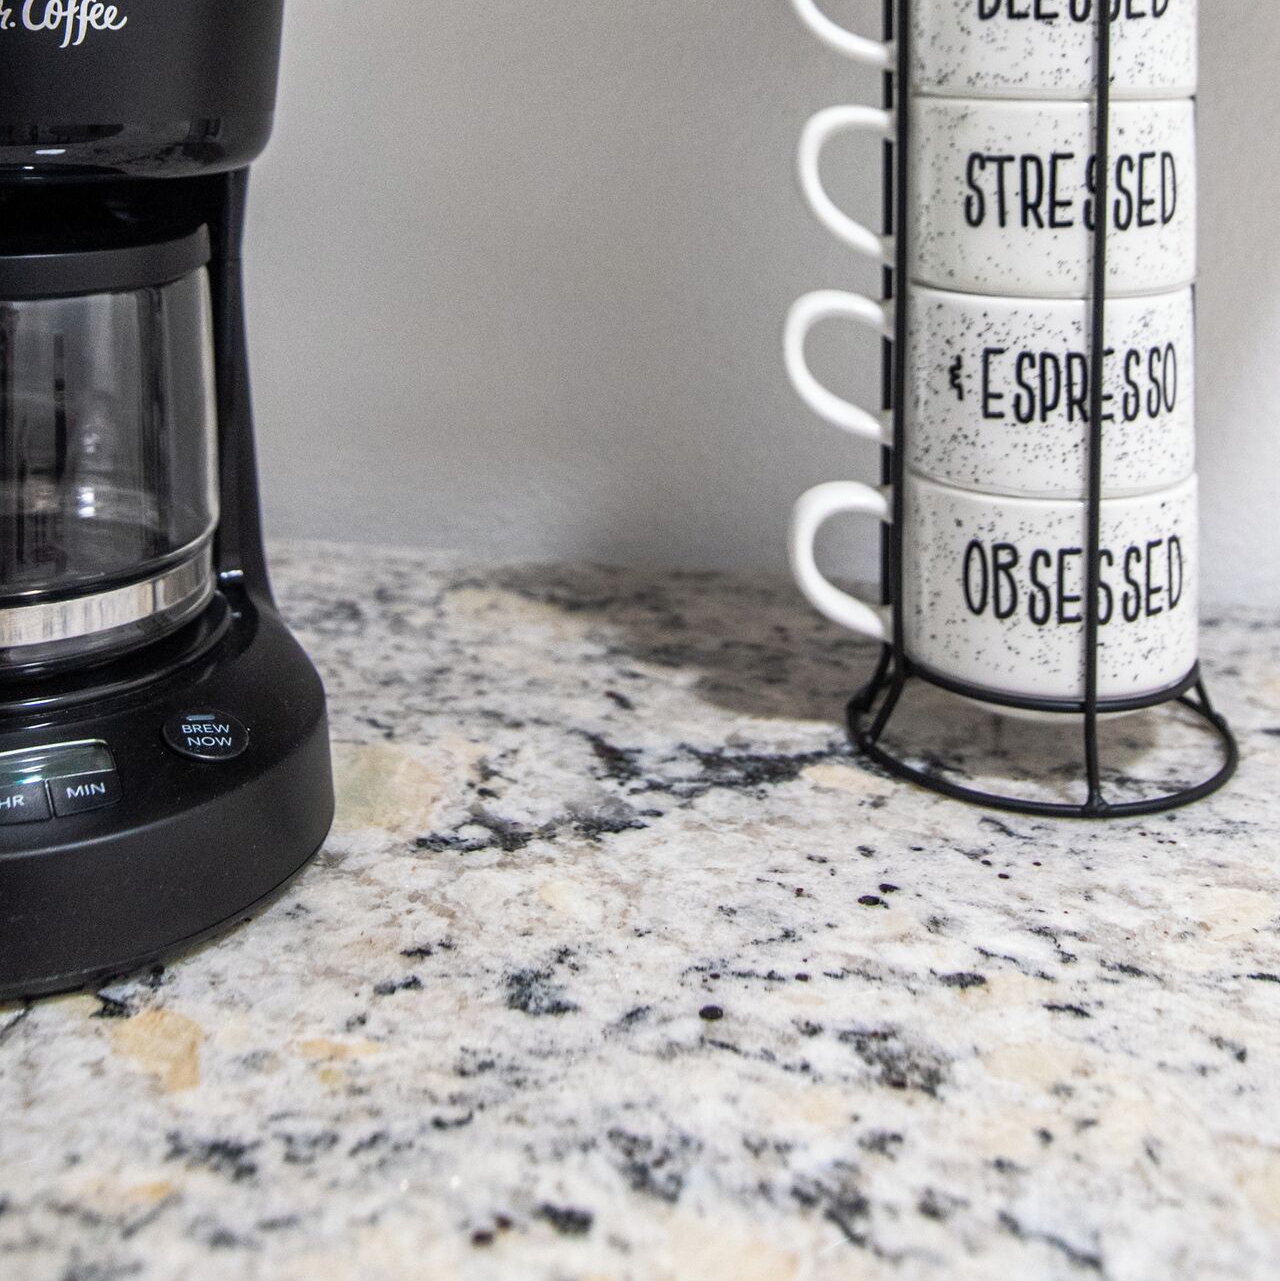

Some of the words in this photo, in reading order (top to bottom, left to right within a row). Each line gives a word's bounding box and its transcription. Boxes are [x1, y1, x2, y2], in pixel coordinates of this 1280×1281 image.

[963, 151, 1178, 232] STRESSED
[981, 341, 1178, 424] ESPRESSO
[961, 534, 1184, 626] OBSESSED
[181, 723, 230, 734] BREW
[186, 736, 232, 747] NOW
[65, 781, 107, 799] MIN
